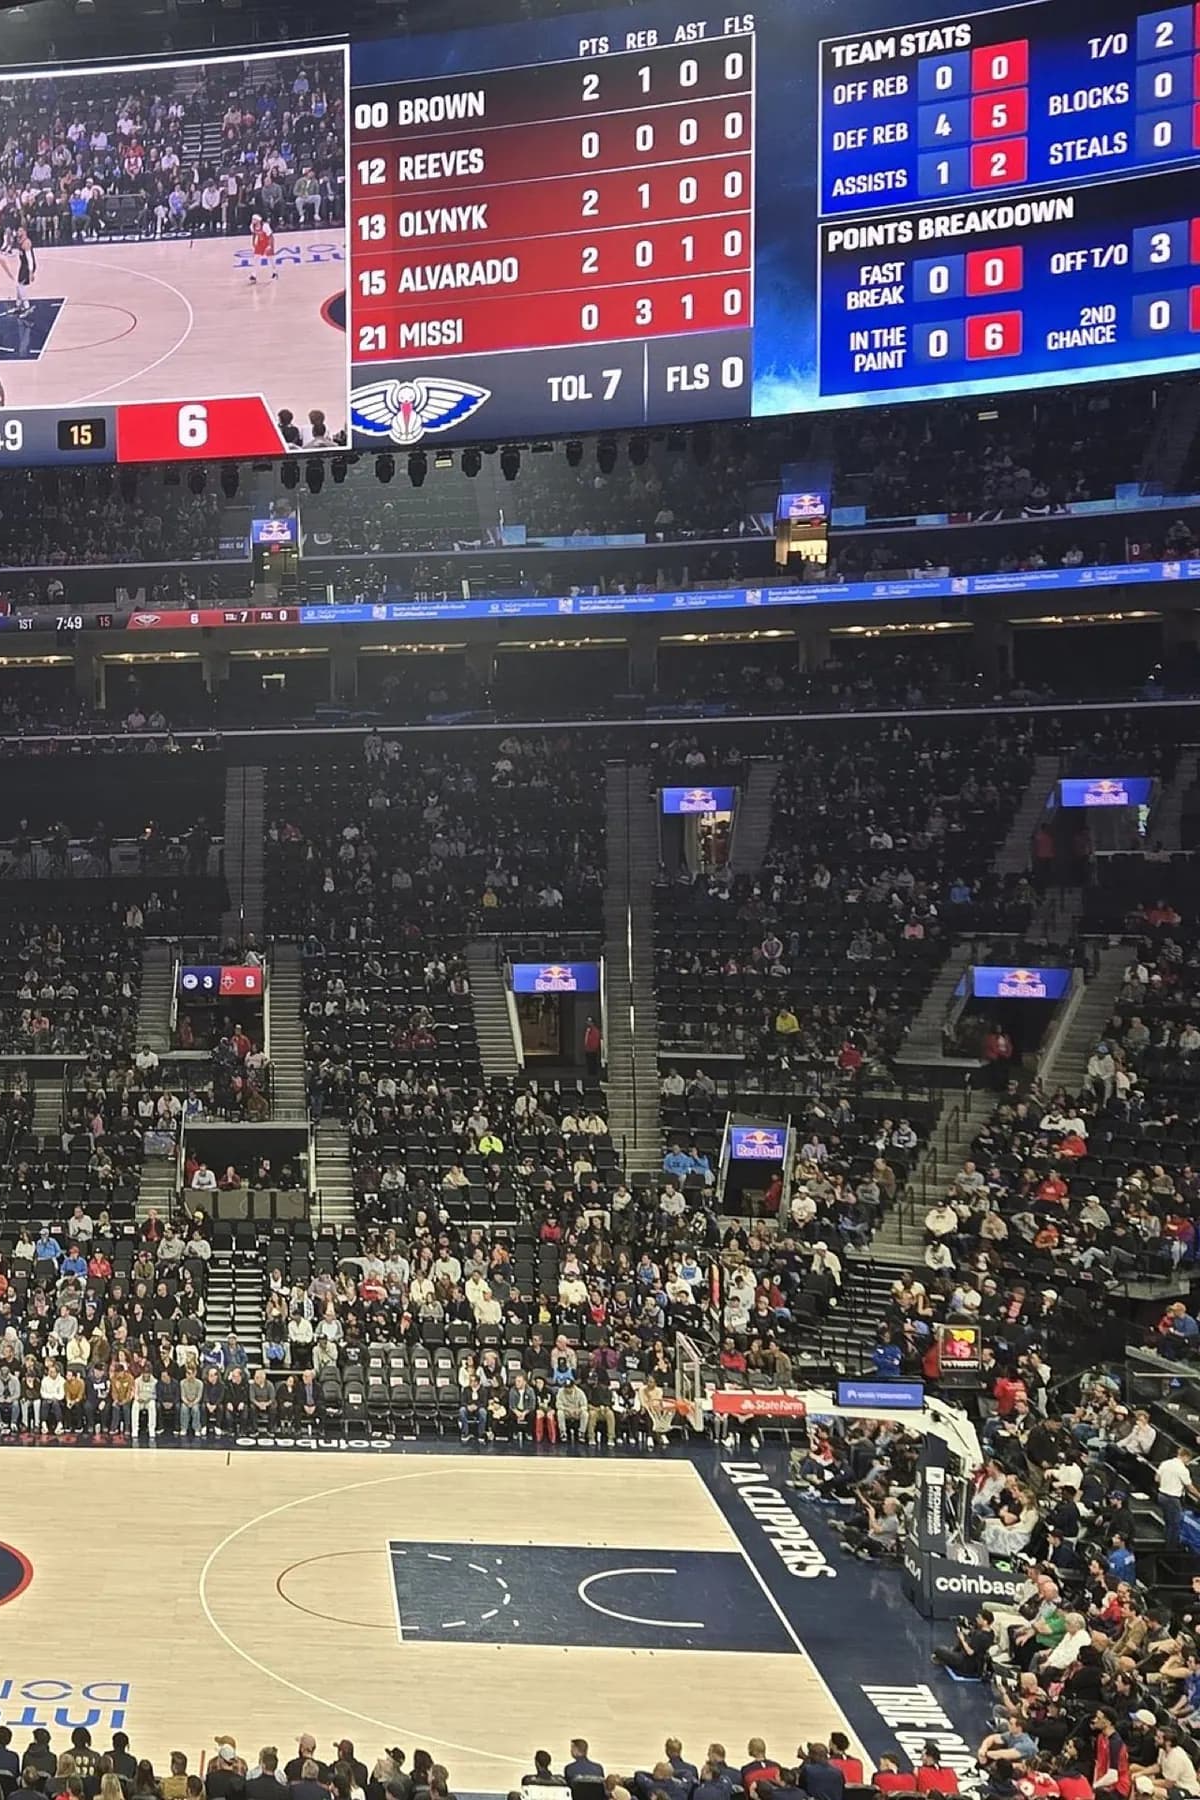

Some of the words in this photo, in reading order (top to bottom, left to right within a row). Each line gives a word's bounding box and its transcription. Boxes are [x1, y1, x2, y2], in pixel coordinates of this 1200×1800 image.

[579, 37, 609, 56] PTS
[626, 30, 658, 50] REB
[675, 22, 706, 42] AST
[724, 15, 754, 34] FLS
[832, 34, 895, 68] TEAM
[900, 24, 971, 56] STATS
[1088, 33, 1128, 59] T/O
[1156, 22, 1173, 47] 2
[355, 102, 387, 129] 00
[399, 91, 485, 125] BROWN
[583, 74, 599, 100] 2
[639, 66, 650, 92] 1
[680, 60, 697, 87] 0
[725, 53, 743, 80] 0
[833, 81, 869, 106] OFF
[874, 75, 908, 98] REB
[936, 66, 952, 90] 0
[992, 55, 1008, 80] 0
[1049, 83, 1128, 116] BLOCKS
[1155, 73, 1172, 97] 0
[833, 127, 869, 151] DEF
[874, 122, 908, 145] REB
[935, 113, 952, 136] 4
[992, 103, 1007, 128] 5
[1049, 132, 1127, 165] STEALS
[1154, 122, 1171, 147] 0
[358, 158, 386, 185] 12
[399, 148, 484, 181] REEVES
[582, 132, 599, 158] 0
[636, 125, 653, 151] 0
[680, 119, 697, 146] 0
[725, 112, 742, 139] 0
[832, 169, 907, 197] ASSISTS
[937, 161, 949, 184] 1
[990, 152, 1006, 177] 2
[358, 215, 386, 240] 13
[399, 205, 488, 237] OLYNYK
[582, 190, 598, 216] 2
[639, 184, 649, 209] 1
[679, 177, 697, 204] 0
[725, 171, 742, 198] 0
[828, 218, 912, 252] POINTS
[918, 196, 1074, 242] BREAKDOWN
[359, 270, 386, 295] 15
[399, 257, 518, 293] ALVARADO
[582, 247, 598, 273] 2
[636, 241, 652, 267] 0
[682, 236, 693, 261] 1
[724, 230, 742, 257] 0
[1051, 253, 1089, 275] OFF
[1092, 243, 1128, 269] T/O
[1150, 232, 1171, 263] 3
[860, 262, 904, 285] FAST
[929, 266, 949, 293] 0
[985, 259, 1003, 286] 0
[847, 285, 904, 310] BREAK
[1080, 304, 1116, 326] 2ND
[1149, 301, 1170, 330] 0
[359, 326, 386, 351] 21
[400, 319, 463, 349] MISSI
[582, 304, 598, 330] 0
[635, 299, 652, 325] 3
[682, 294, 693, 319] 1
[724, 288, 741, 315] 0
[850, 331, 868, 351] IN
[871, 326, 907, 348] THE
[928, 329, 948, 357] 0
[984, 323, 1003, 350] 6
[1047, 324, 1116, 350] CHANCE
[667, 364, 709, 392] FLS
[722, 357, 743, 388] 0
[854, 350, 906, 372] PAINT
[548, 374, 592, 401] TOL
[602, 369, 622, 400] 7
[70, 425, 92, 446] 15
[178, 405, 207, 446] 6
[56, 616, 82, 630] 7:49
[204, 976, 212, 987] 3
[235, 1438, 392, 1449] coinbase
[721, 1462, 769, 1484] LA
[738, 1487, 837, 1578] CLIPPERS
[860, 1684, 954, 1729] TRUE
